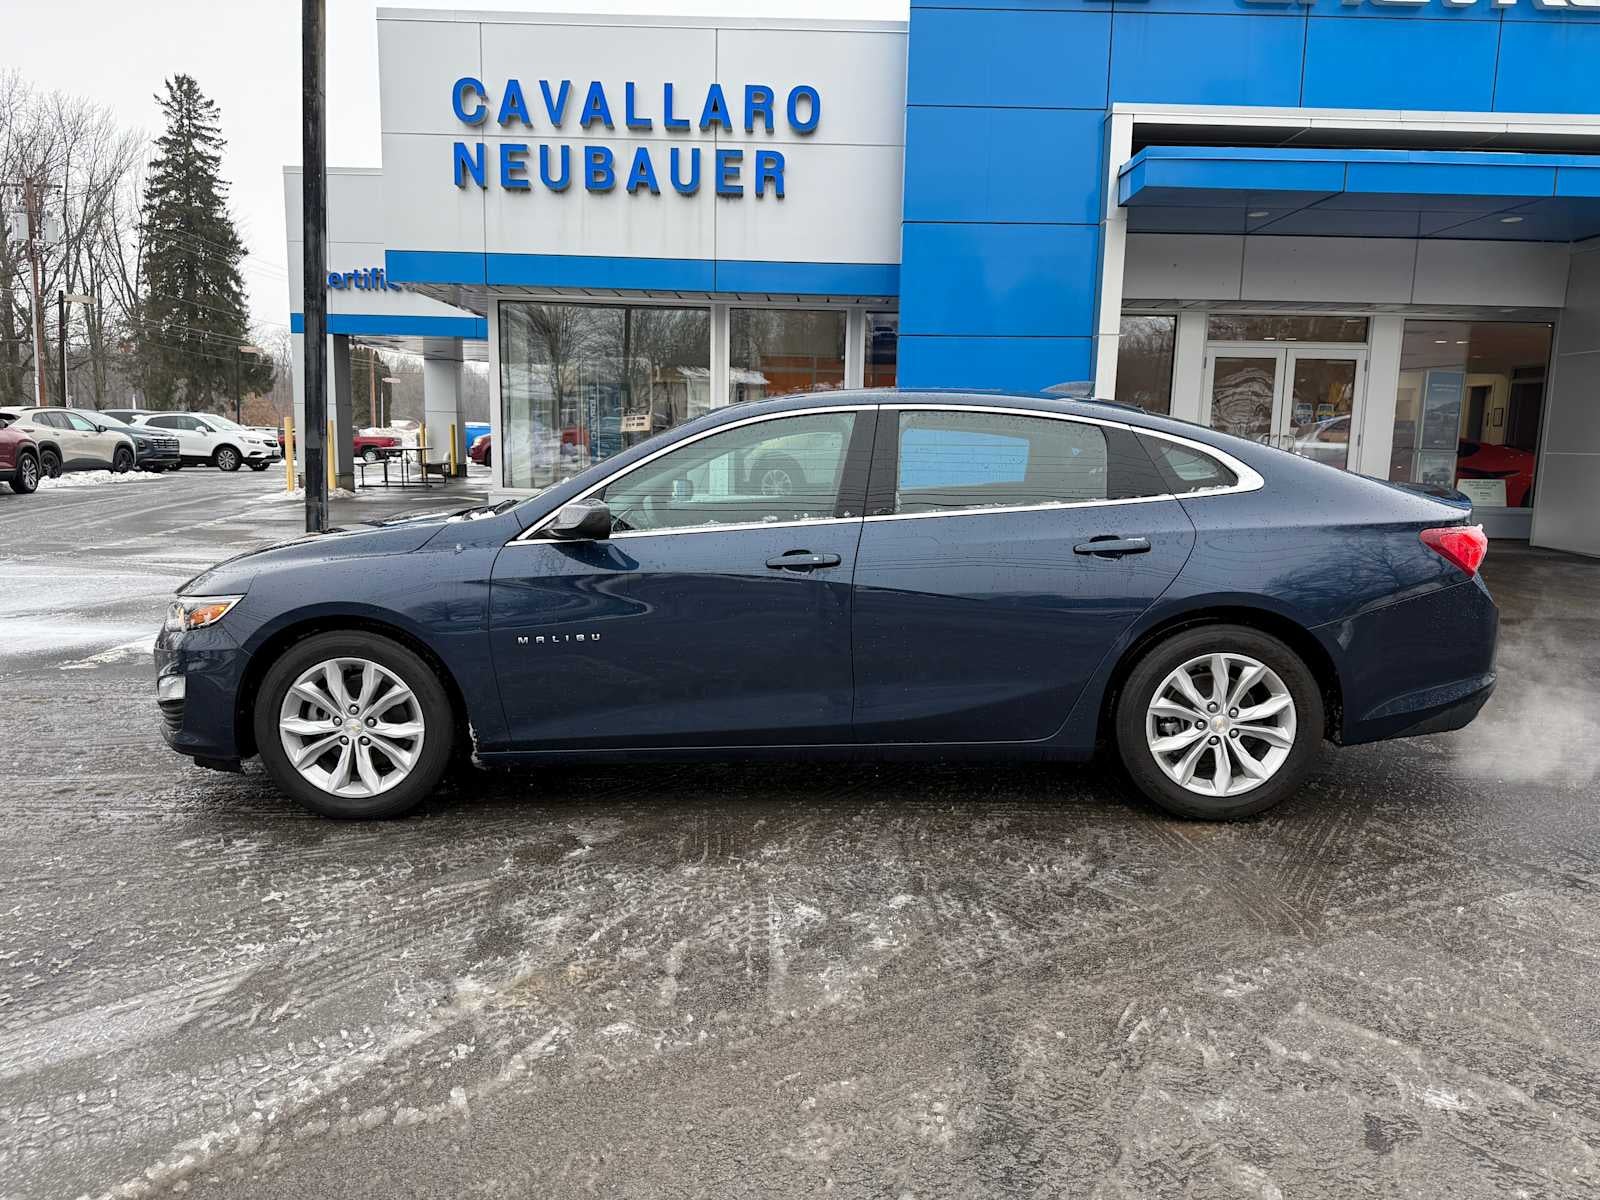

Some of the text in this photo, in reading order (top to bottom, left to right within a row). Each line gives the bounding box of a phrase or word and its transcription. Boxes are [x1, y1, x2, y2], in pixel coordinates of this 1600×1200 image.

[452, 77, 821, 134] CAVALLARO
[453, 142, 786, 199] NEUBAUER
[327, 267, 402, 292] ertifi
[517, 633, 601, 645] MALIBU
